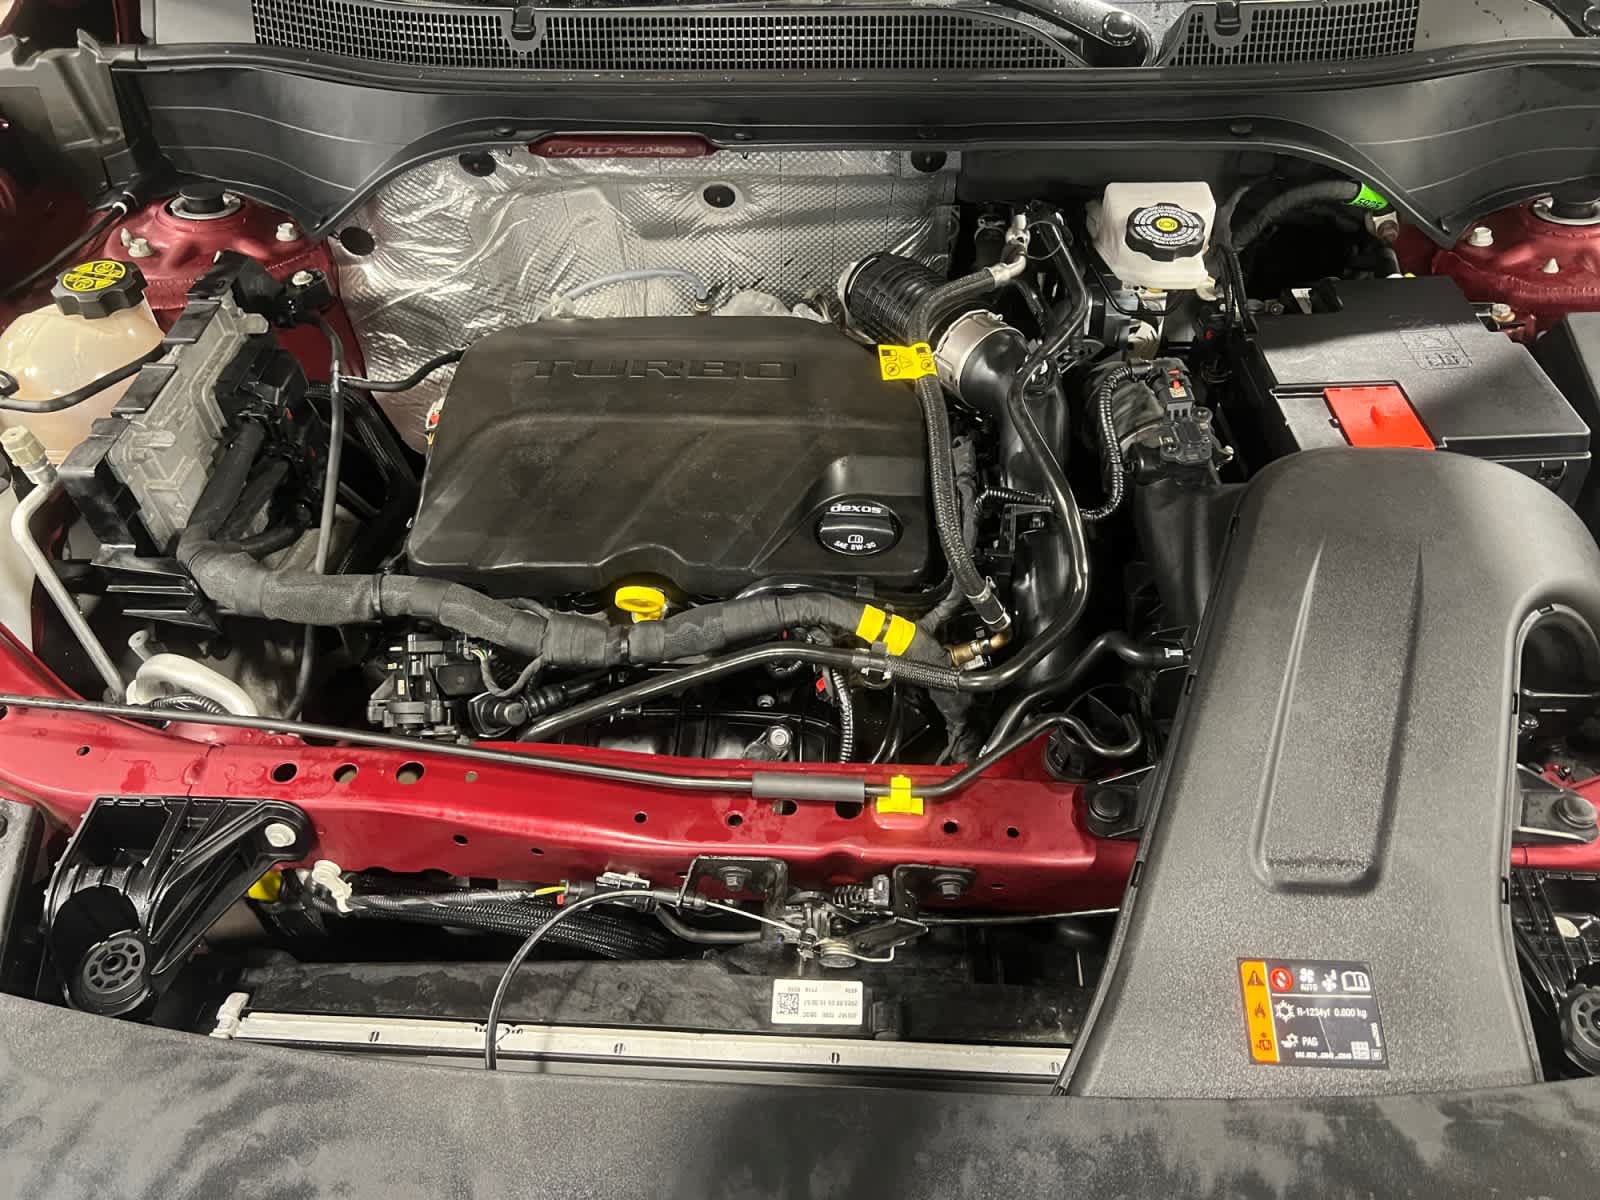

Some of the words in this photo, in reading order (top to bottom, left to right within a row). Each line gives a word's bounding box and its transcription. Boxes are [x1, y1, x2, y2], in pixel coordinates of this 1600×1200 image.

[513, 359, 797, 380] TURBO
[830, 503, 882, 514] dexos
[1357, 1007, 1368, 1019] kg
[1301, 1036, 1319, 1047] PAG
